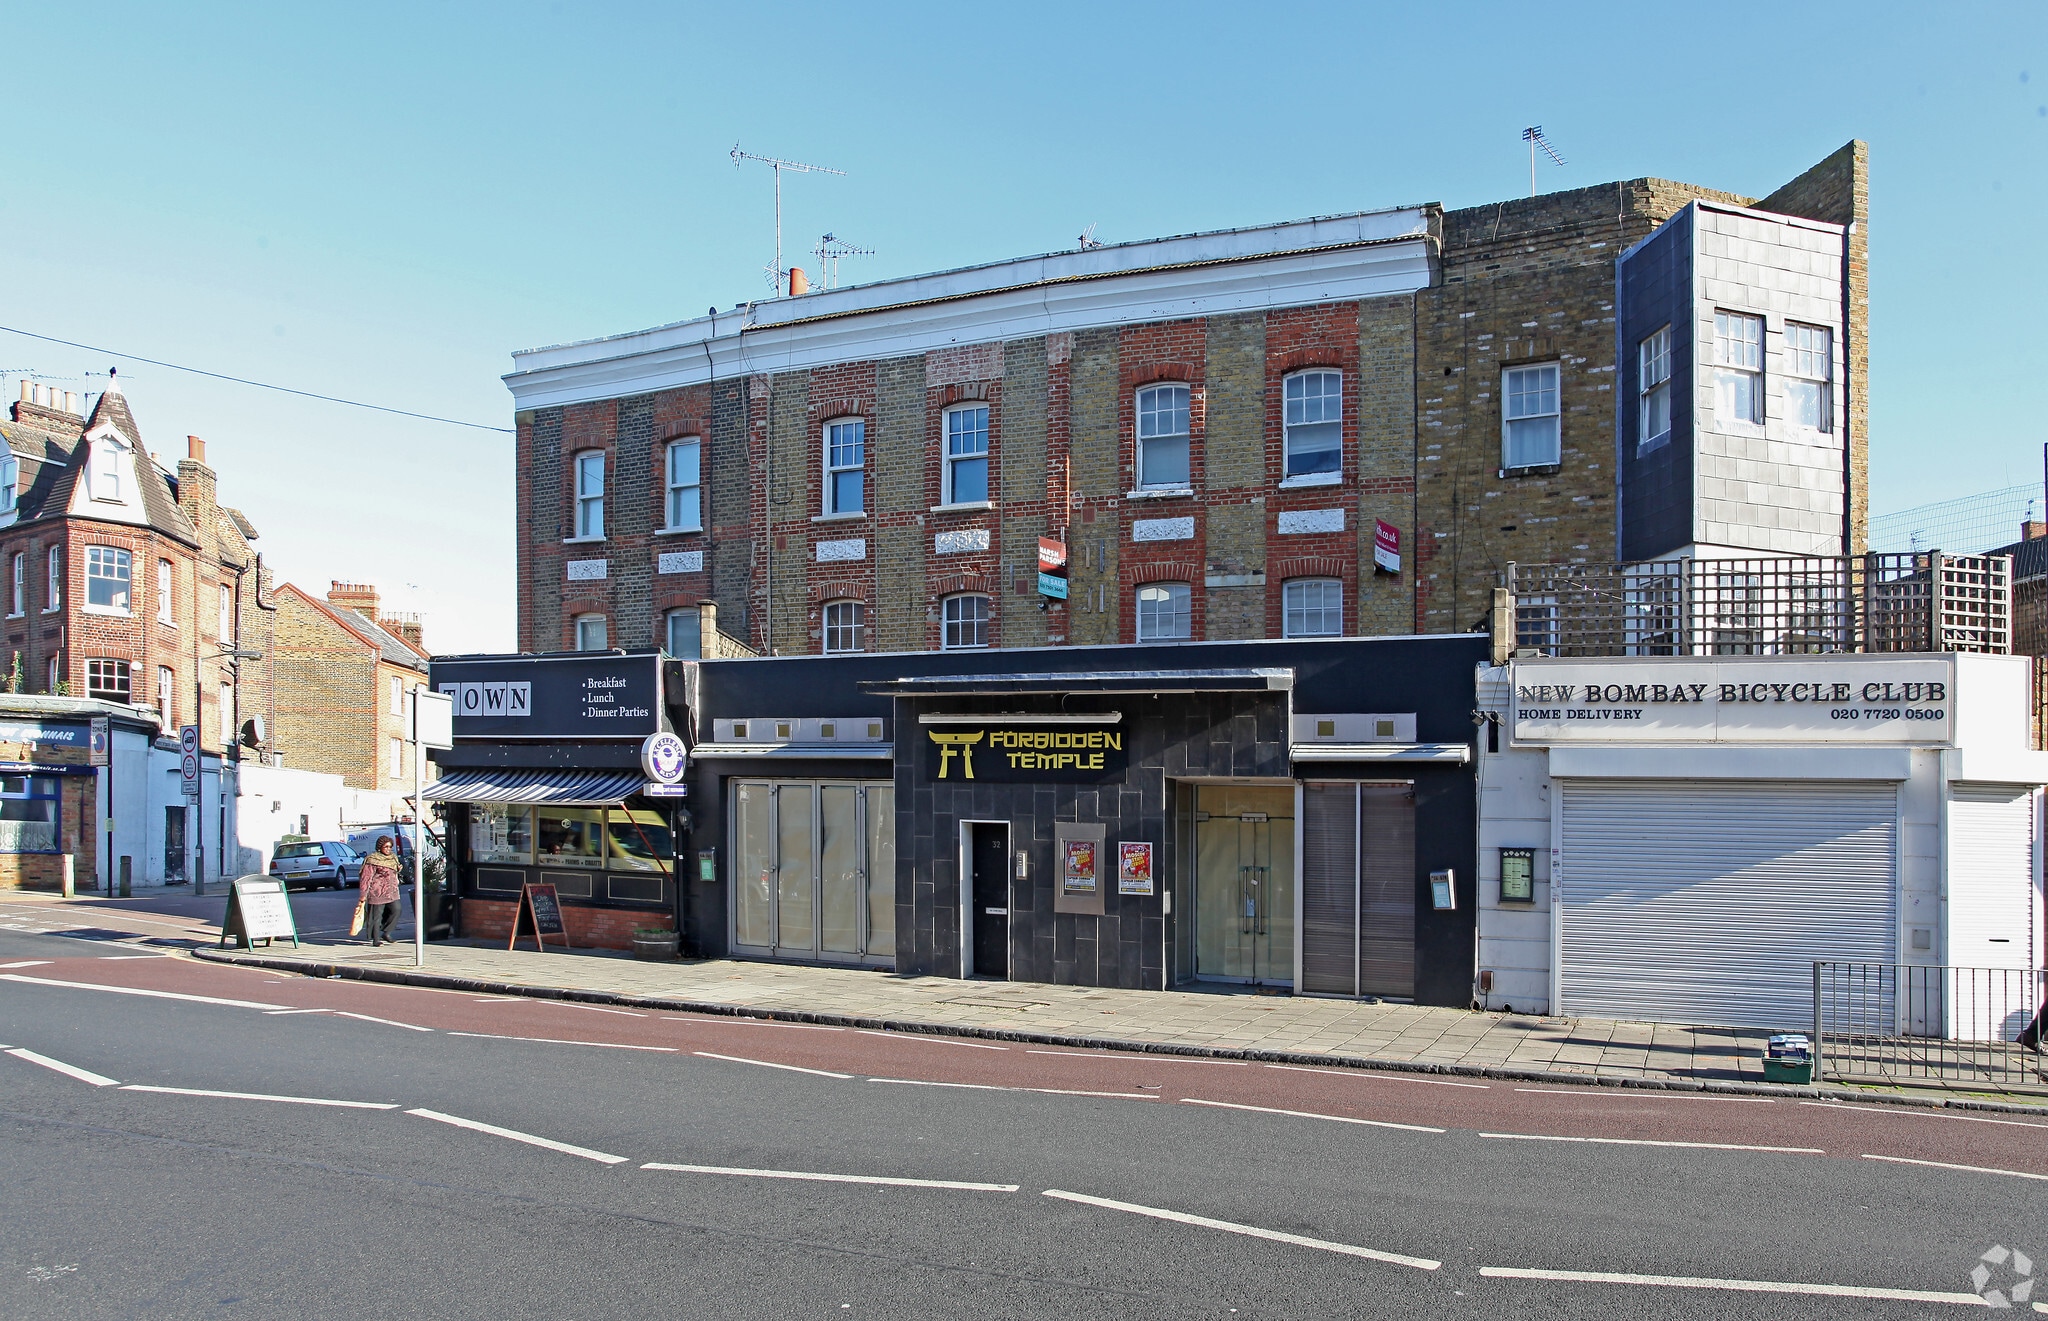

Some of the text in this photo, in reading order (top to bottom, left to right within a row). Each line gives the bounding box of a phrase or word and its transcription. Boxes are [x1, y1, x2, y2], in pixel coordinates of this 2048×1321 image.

[1040, 546, 1059, 558] MARSH
[1040, 553, 1066, 567] PARSONS
[1040, 575, 1065, 588] FOR SALE
[587, 677, 627, 688] Breakfast
[587, 692, 615, 703] Lunch
[1519, 681, 1947, 703] NEW BOMBAY BICYCLE CLUB
[587, 706, 649, 718] Dinner Parties
[1518, 709, 1643, 720] HOME DELIVERY
[1830, 708, 1945, 720] 020 7720 0500
[989, 730, 1122, 751] FORBIDDEN
[1006, 751, 1104, 770] TEMPLE
